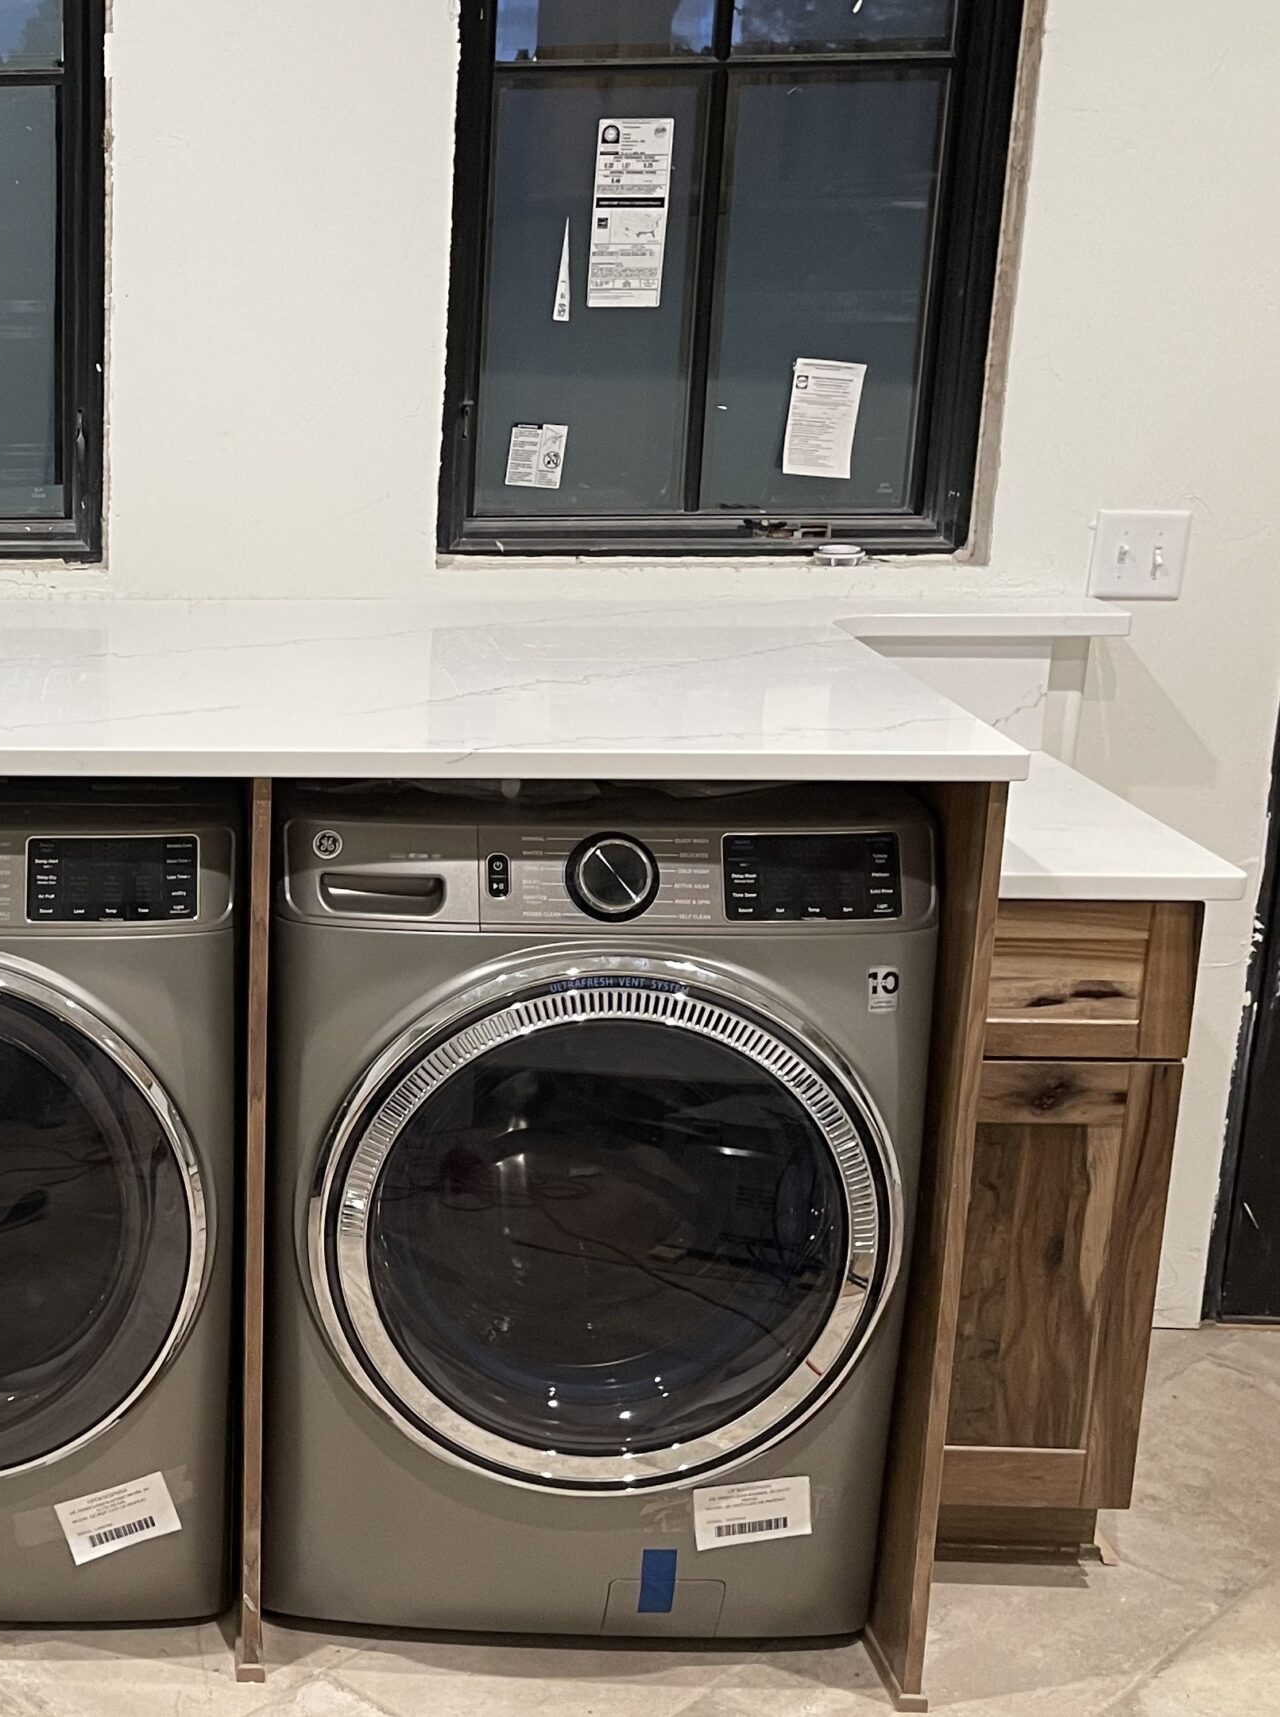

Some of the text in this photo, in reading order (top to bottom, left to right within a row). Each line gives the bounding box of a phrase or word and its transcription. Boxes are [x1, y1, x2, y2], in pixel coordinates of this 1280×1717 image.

[550, 976, 690, 995] ULTRAFRESH VENT SYSTEM
[868, 971, 899, 994] 10
